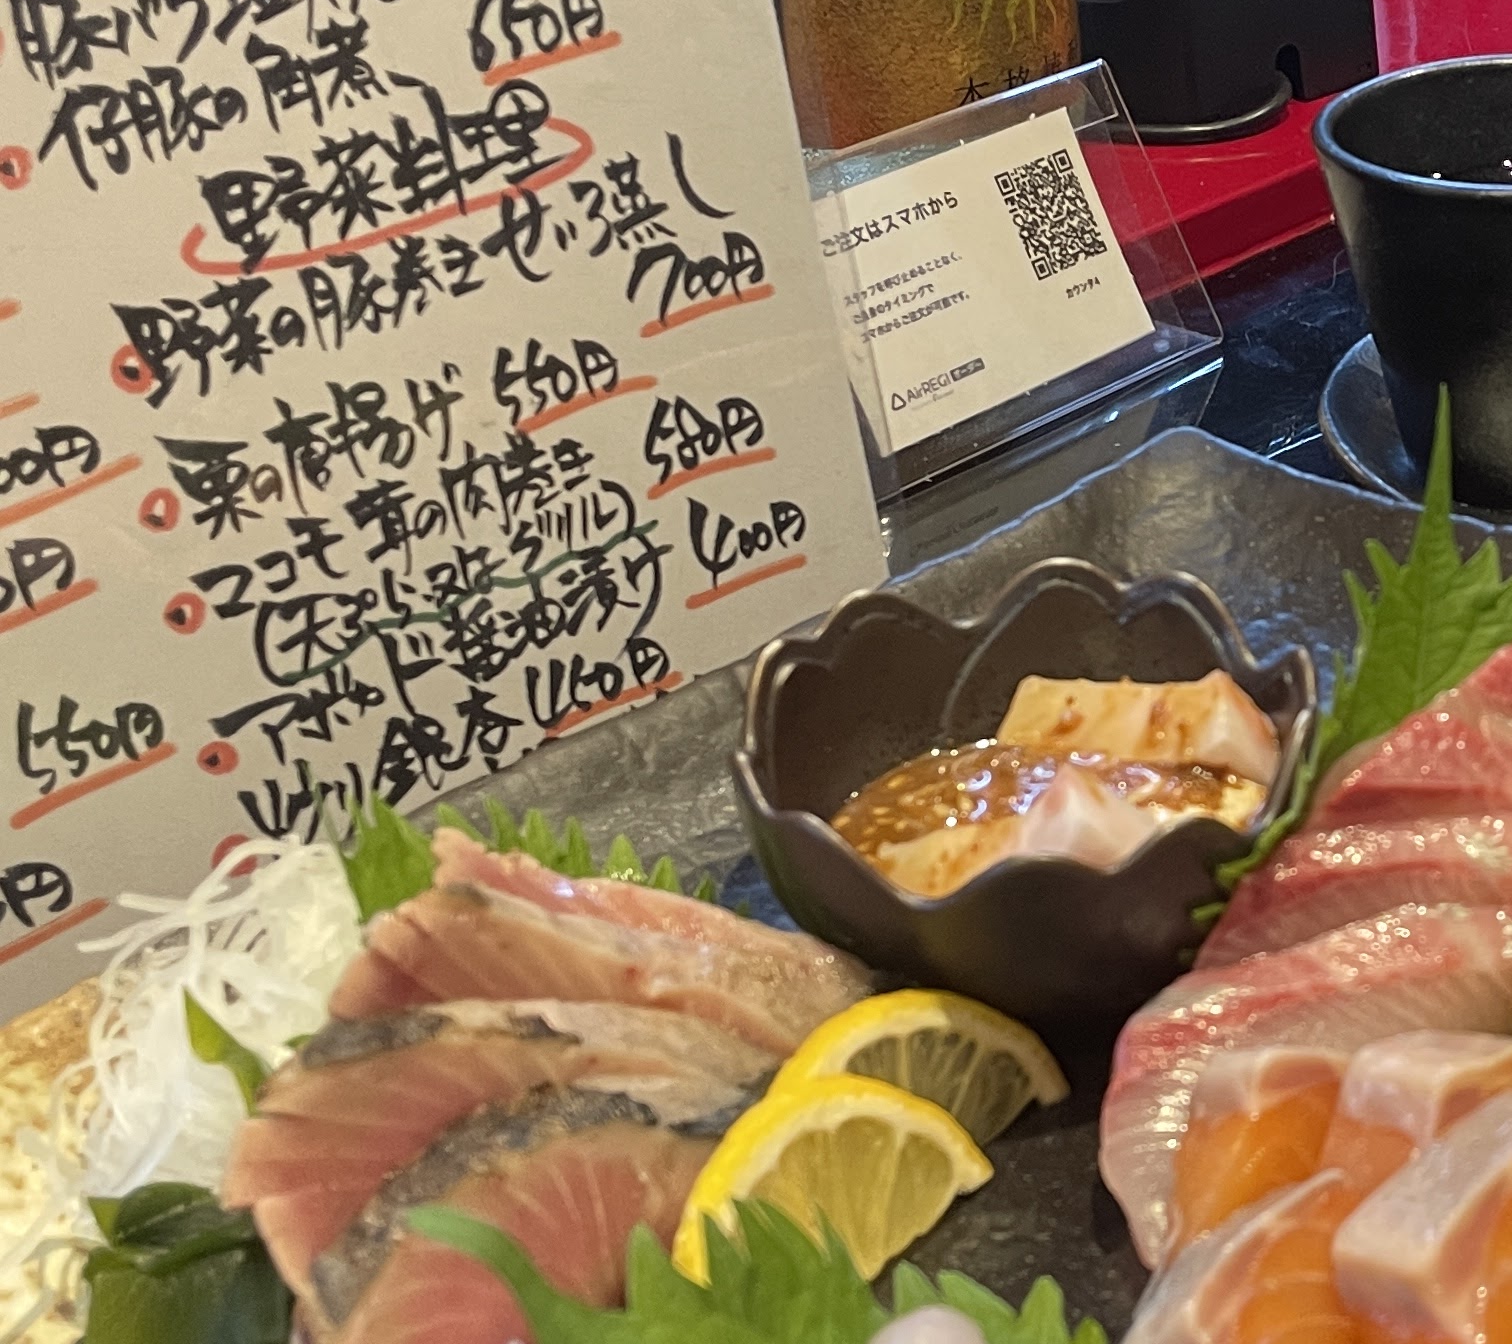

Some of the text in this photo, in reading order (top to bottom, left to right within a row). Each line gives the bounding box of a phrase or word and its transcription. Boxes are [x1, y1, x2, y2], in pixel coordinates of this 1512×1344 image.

[200, 70, 571, 273] 野菜料理
[820, 191, 958, 257] ご注文はスマホから
[628, 232, 766, 324] 700円
[494, 336, 619, 428] 550円
[645, 396, 766, 488] 580円
[689, 496, 806, 590] 400円
[17, 695, 165, 795] 550円
